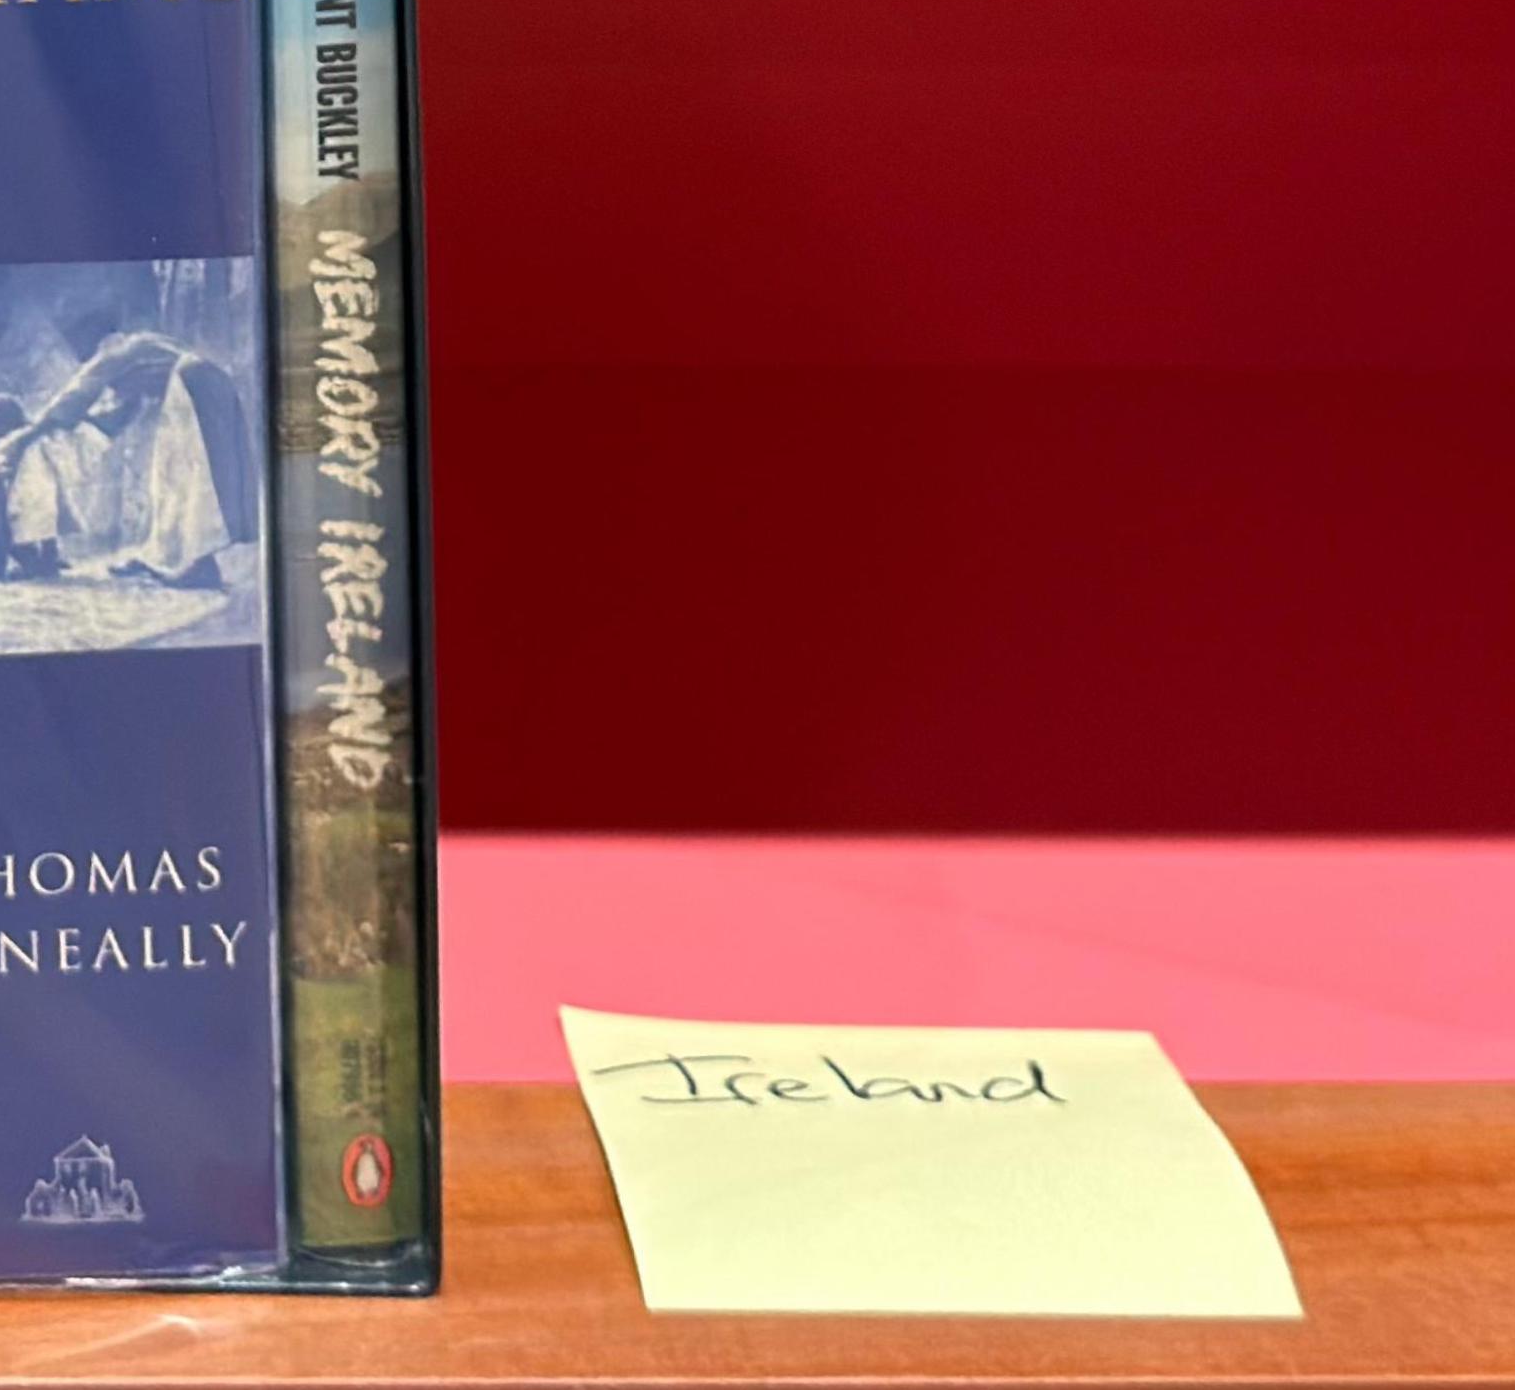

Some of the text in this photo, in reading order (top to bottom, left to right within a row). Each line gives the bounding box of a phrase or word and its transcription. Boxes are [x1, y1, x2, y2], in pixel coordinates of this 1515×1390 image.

[316, 43, 361, 182] BUCKLEY
[308, 230, 394, 790] MEMORY IRELAND
[590, 1051, 1068, 1108] Ireland
